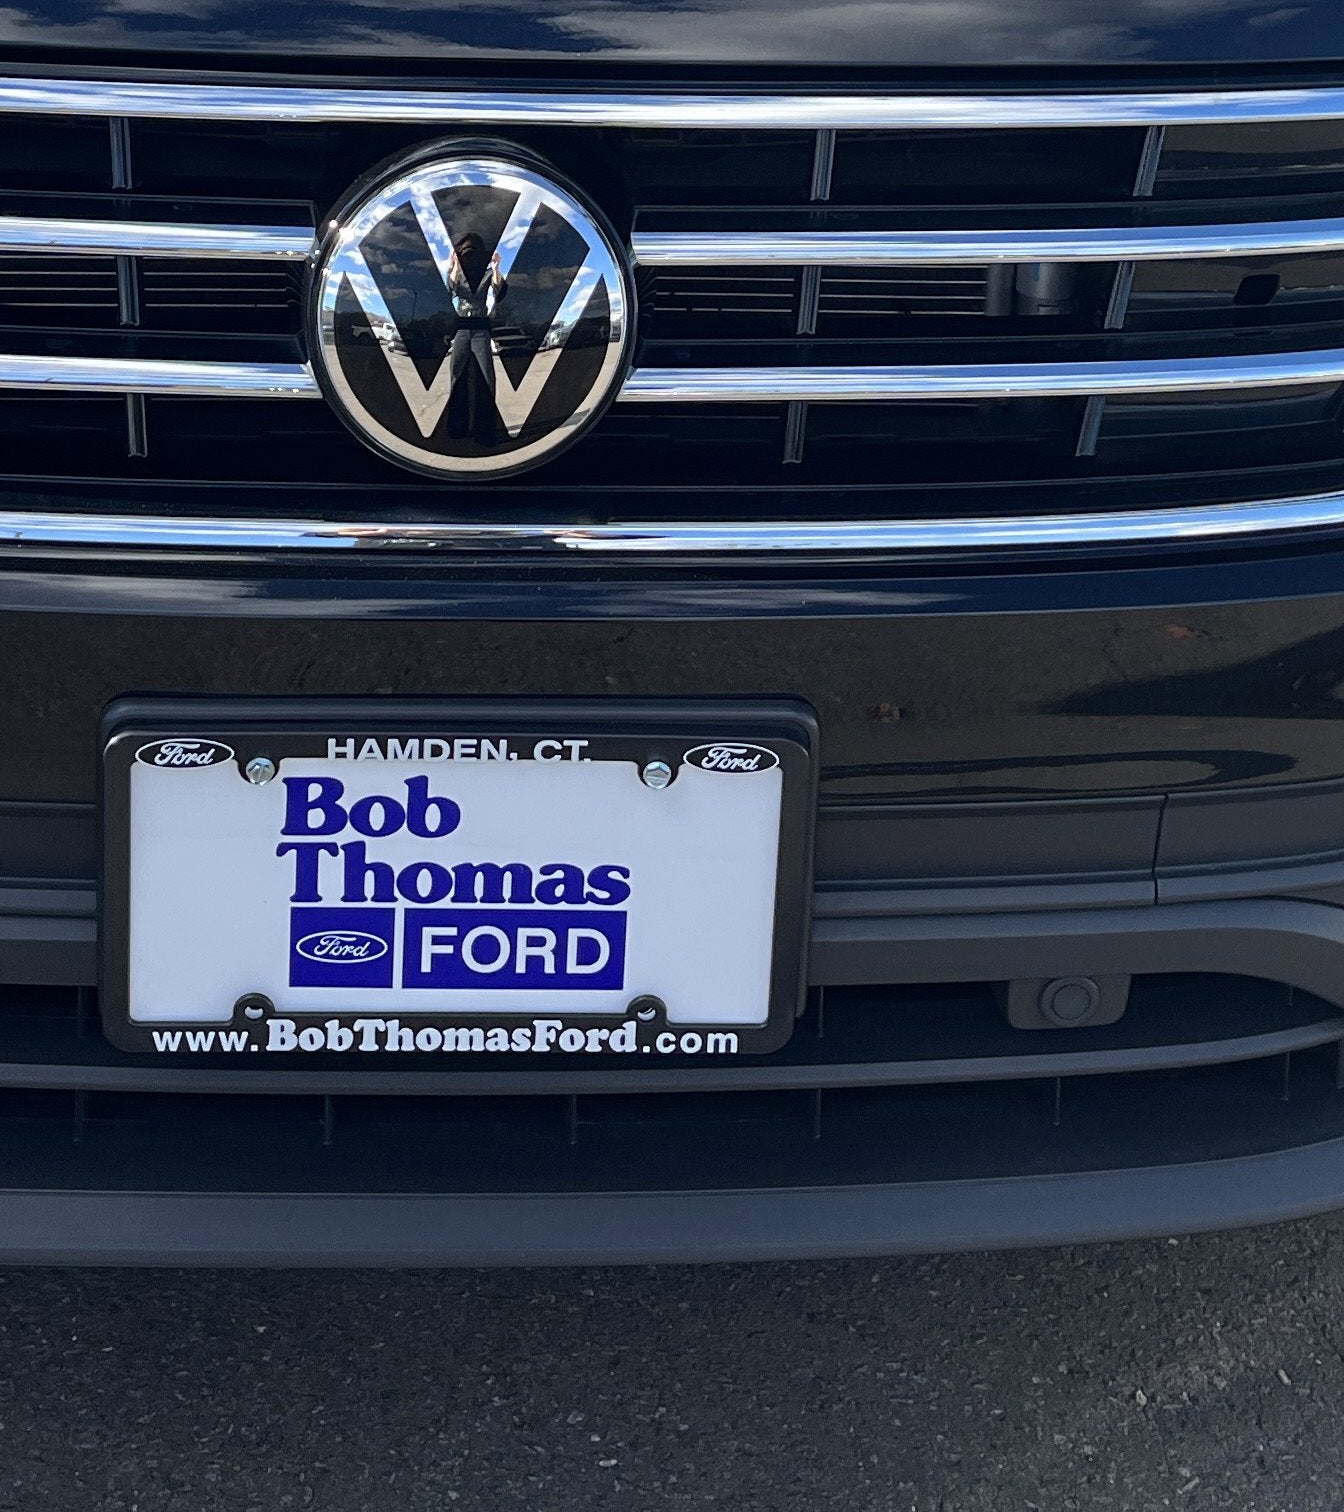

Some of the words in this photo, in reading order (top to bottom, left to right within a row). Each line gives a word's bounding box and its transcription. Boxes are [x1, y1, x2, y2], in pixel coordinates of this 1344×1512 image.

[154, 742, 216, 766] Ford
[327, 738, 518, 762] HAMDEN,
[533, 740, 592, 763] CT.
[701, 746, 761, 772] Ford
[280, 775, 461, 838] Bob
[276, 840, 631, 905] Thomas
[313, 934, 371, 958] Ford
[420, 925, 611, 975] FORD
[152, 1018, 739, 1054] www.BobThomasFord.com
